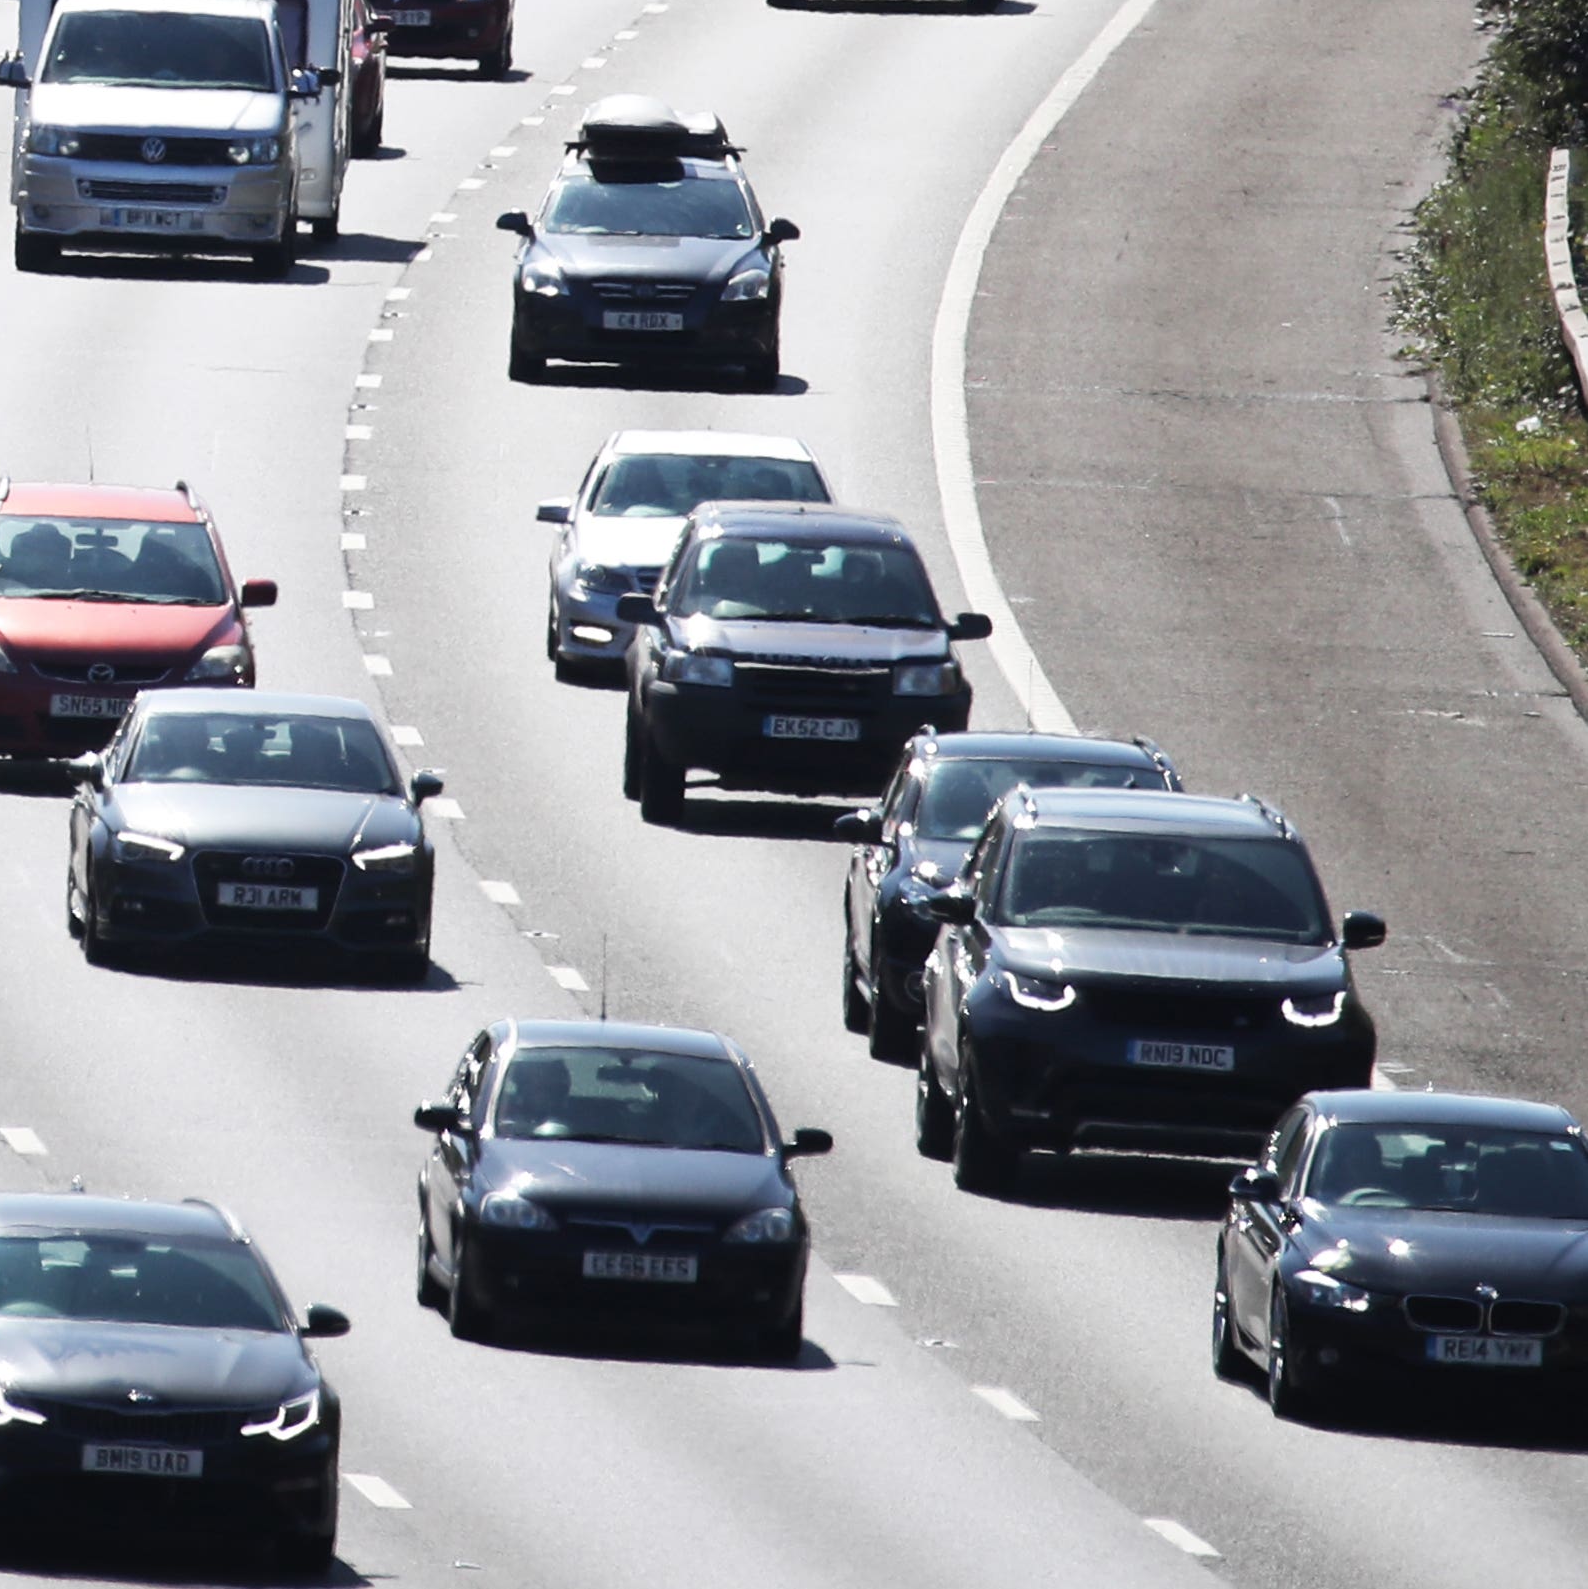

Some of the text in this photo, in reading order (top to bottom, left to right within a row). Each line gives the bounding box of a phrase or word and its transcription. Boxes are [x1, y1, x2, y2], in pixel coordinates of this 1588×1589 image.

[58, 697, 103, 714] SN55
[772, 718, 819, 736] EK52
[267, 889, 302, 905] ARM
[1141, 1042, 1226, 1066] RN19 NDC
[1444, 1338, 1488, 1360] RE14
[96, 1449, 142, 1468] BM19
